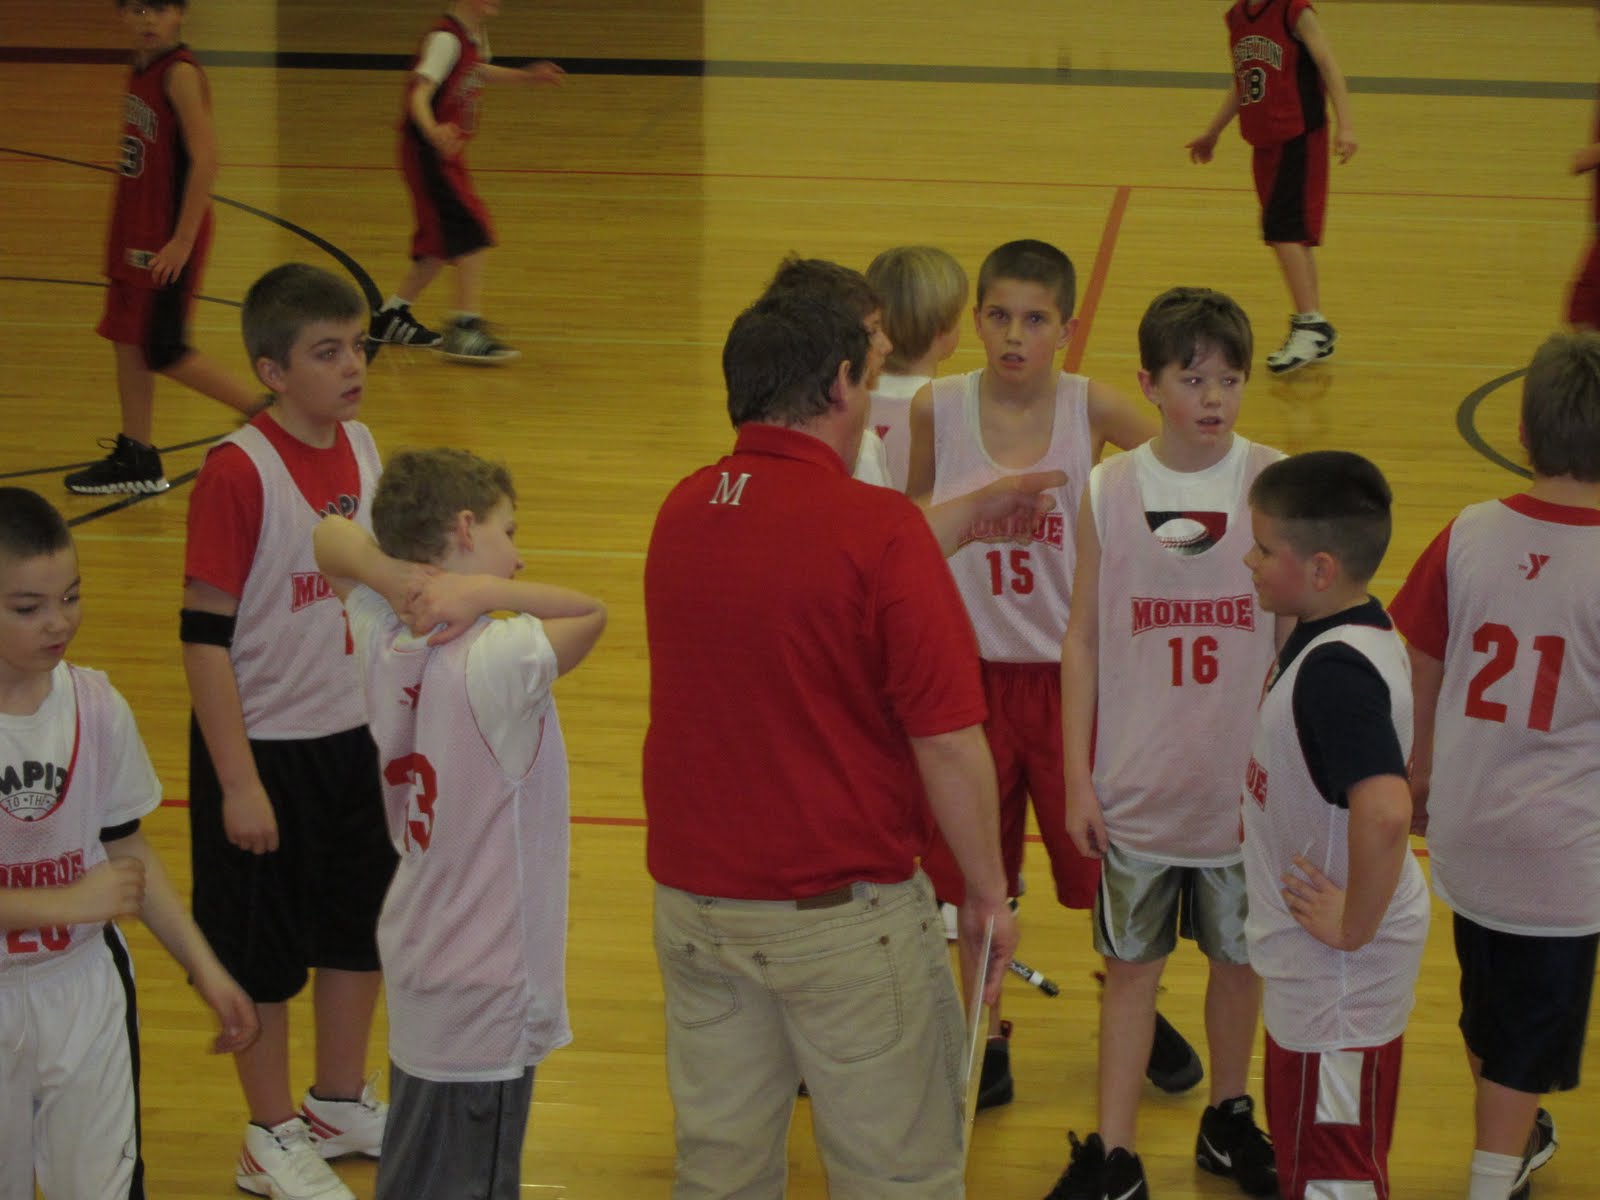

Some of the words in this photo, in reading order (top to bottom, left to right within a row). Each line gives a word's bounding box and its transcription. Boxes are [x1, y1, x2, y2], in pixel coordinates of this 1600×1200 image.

[708, 471, 753, 506] M
[985, 549, 1034, 596] 15
[1131, 594, 1256, 637] MONROE
[1168, 635, 1219, 687] 16
[1464, 621, 1566, 733] 21
